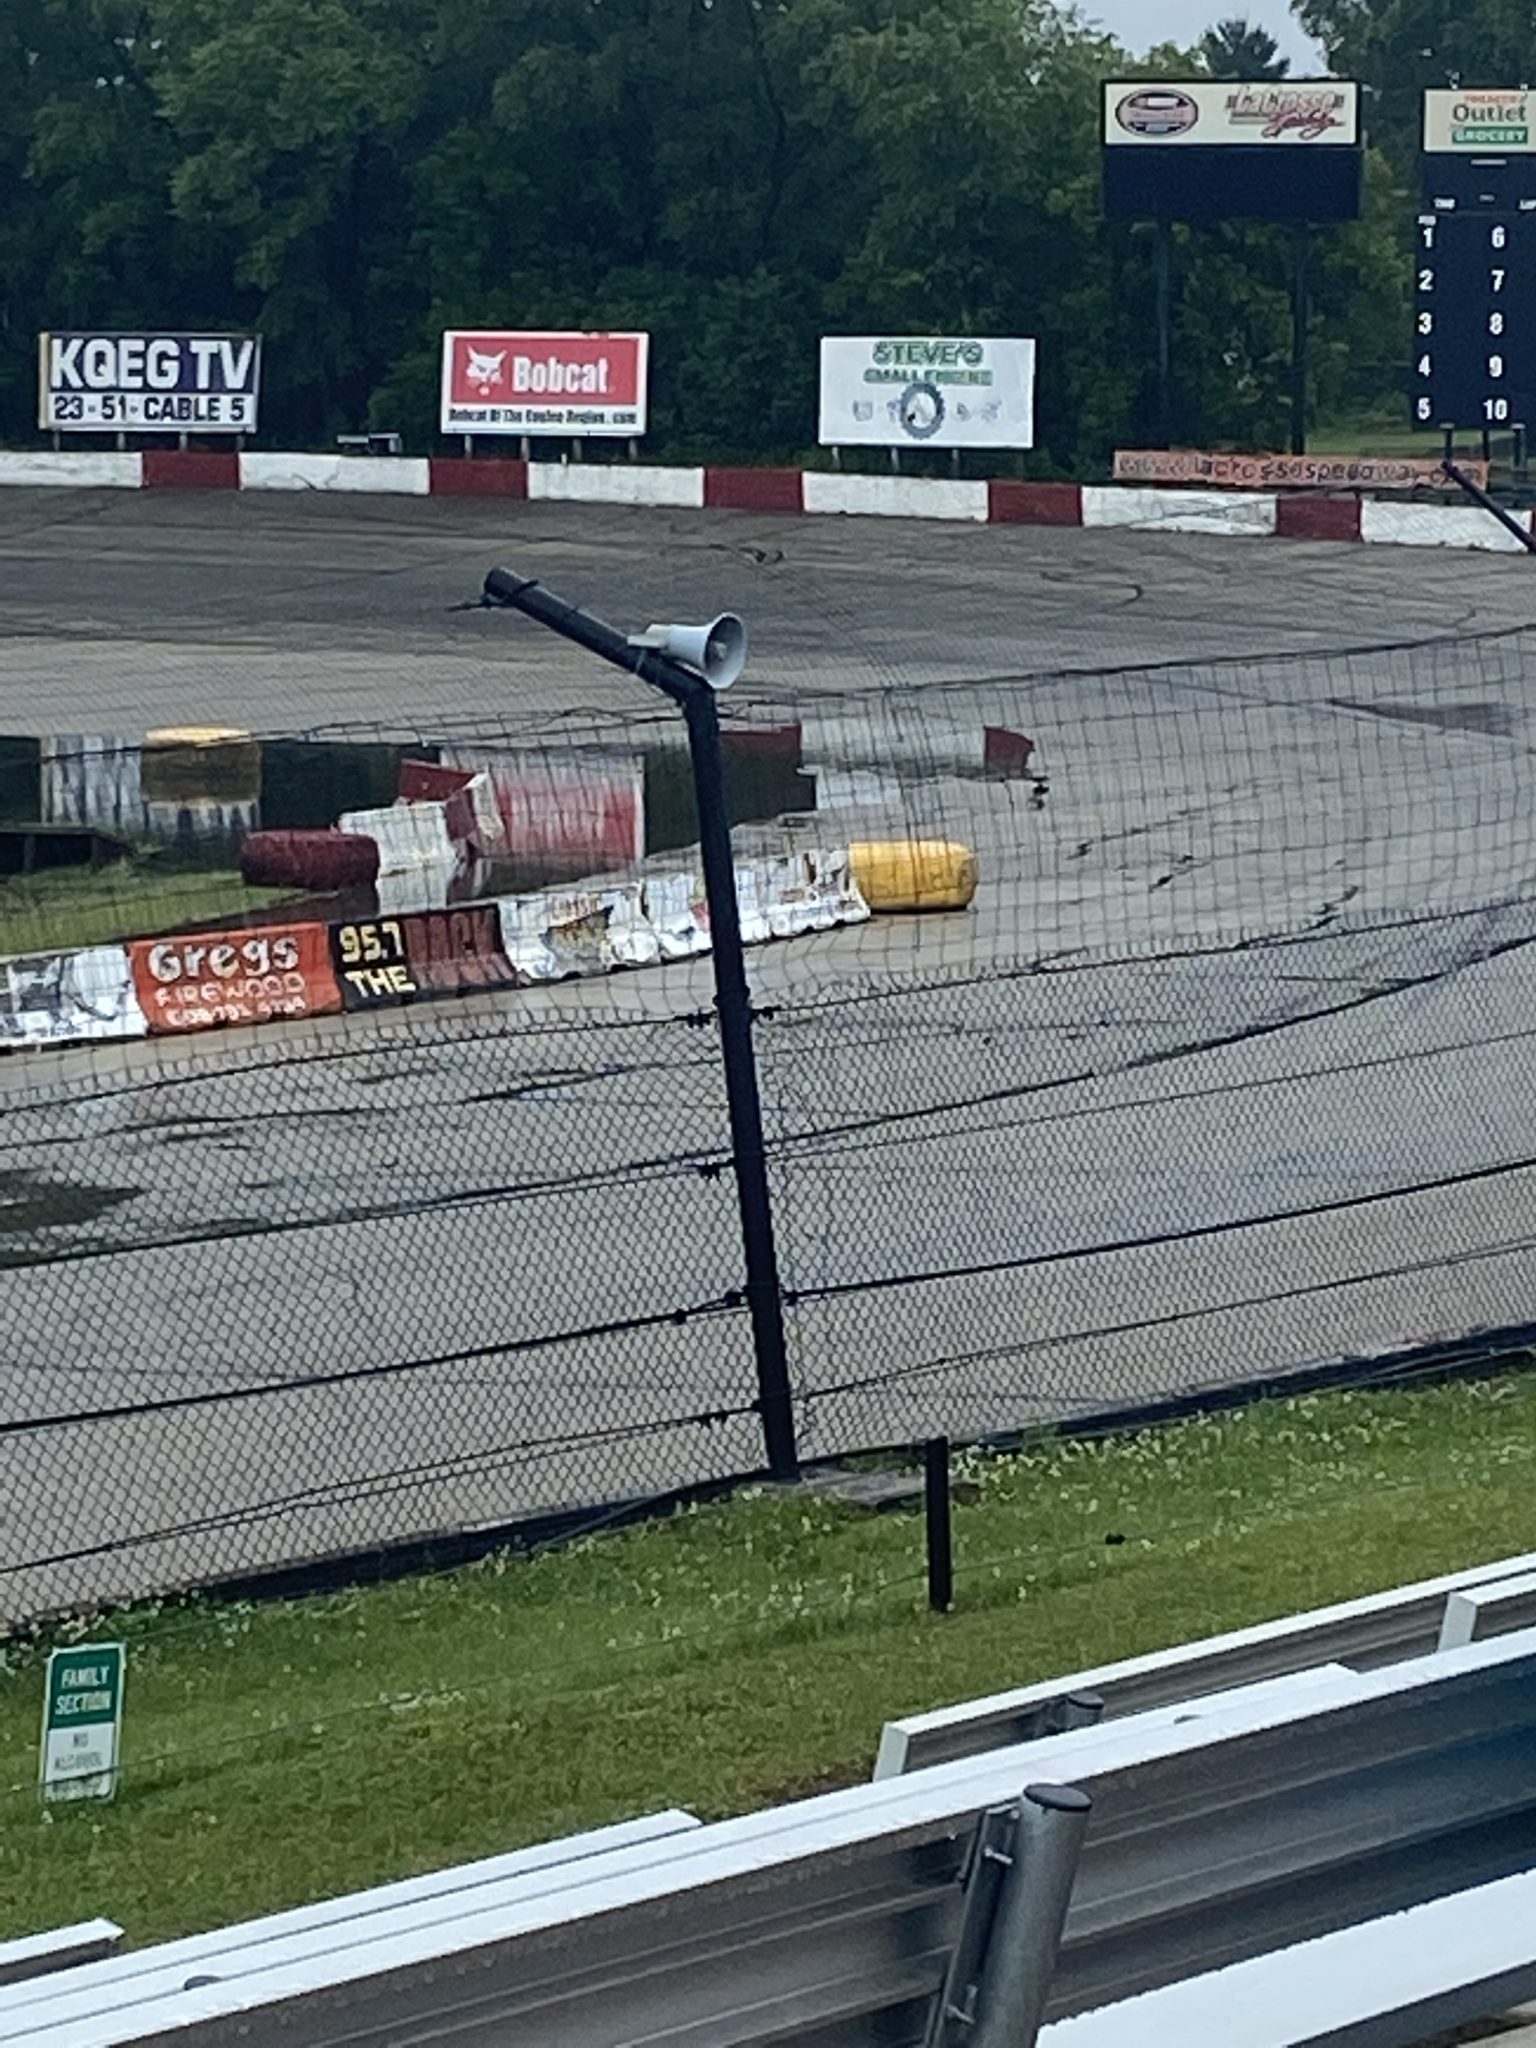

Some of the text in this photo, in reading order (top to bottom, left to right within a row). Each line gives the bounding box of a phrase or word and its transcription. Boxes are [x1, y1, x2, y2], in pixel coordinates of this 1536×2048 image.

[1453, 103, 1526, 122] Outlet
[1423, 227, 1433, 248] 1
[1491, 226, 1505, 248] 6
[1418, 269, 1434, 291] 2
[1491, 269, 1505, 292] 7
[1418, 312, 1432, 335] 3
[1489, 312, 1503, 335] 8
[51, 338, 254, 389] KQEG TV
[872, 341, 983, 367] STEVE'S
[1418, 354, 1431, 377] 4
[512, 356, 608, 394] Bobcat
[1489, 355, 1503, 377] 9
[54, 395, 84, 420] 23
[144, 396, 221, 421] CABLE
[229, 398, 245, 421] 5
[1417, 397, 1431, 420] 5
[1483, 399, 1508, 420] 10
[339, 921, 403, 963] 95.7
[148, 936, 299, 983] Gregs
[344, 965, 417, 998] THE
[61, 1665, 110, 1689] FAMILY
[54, 1690, 112, 1716] SECTION
